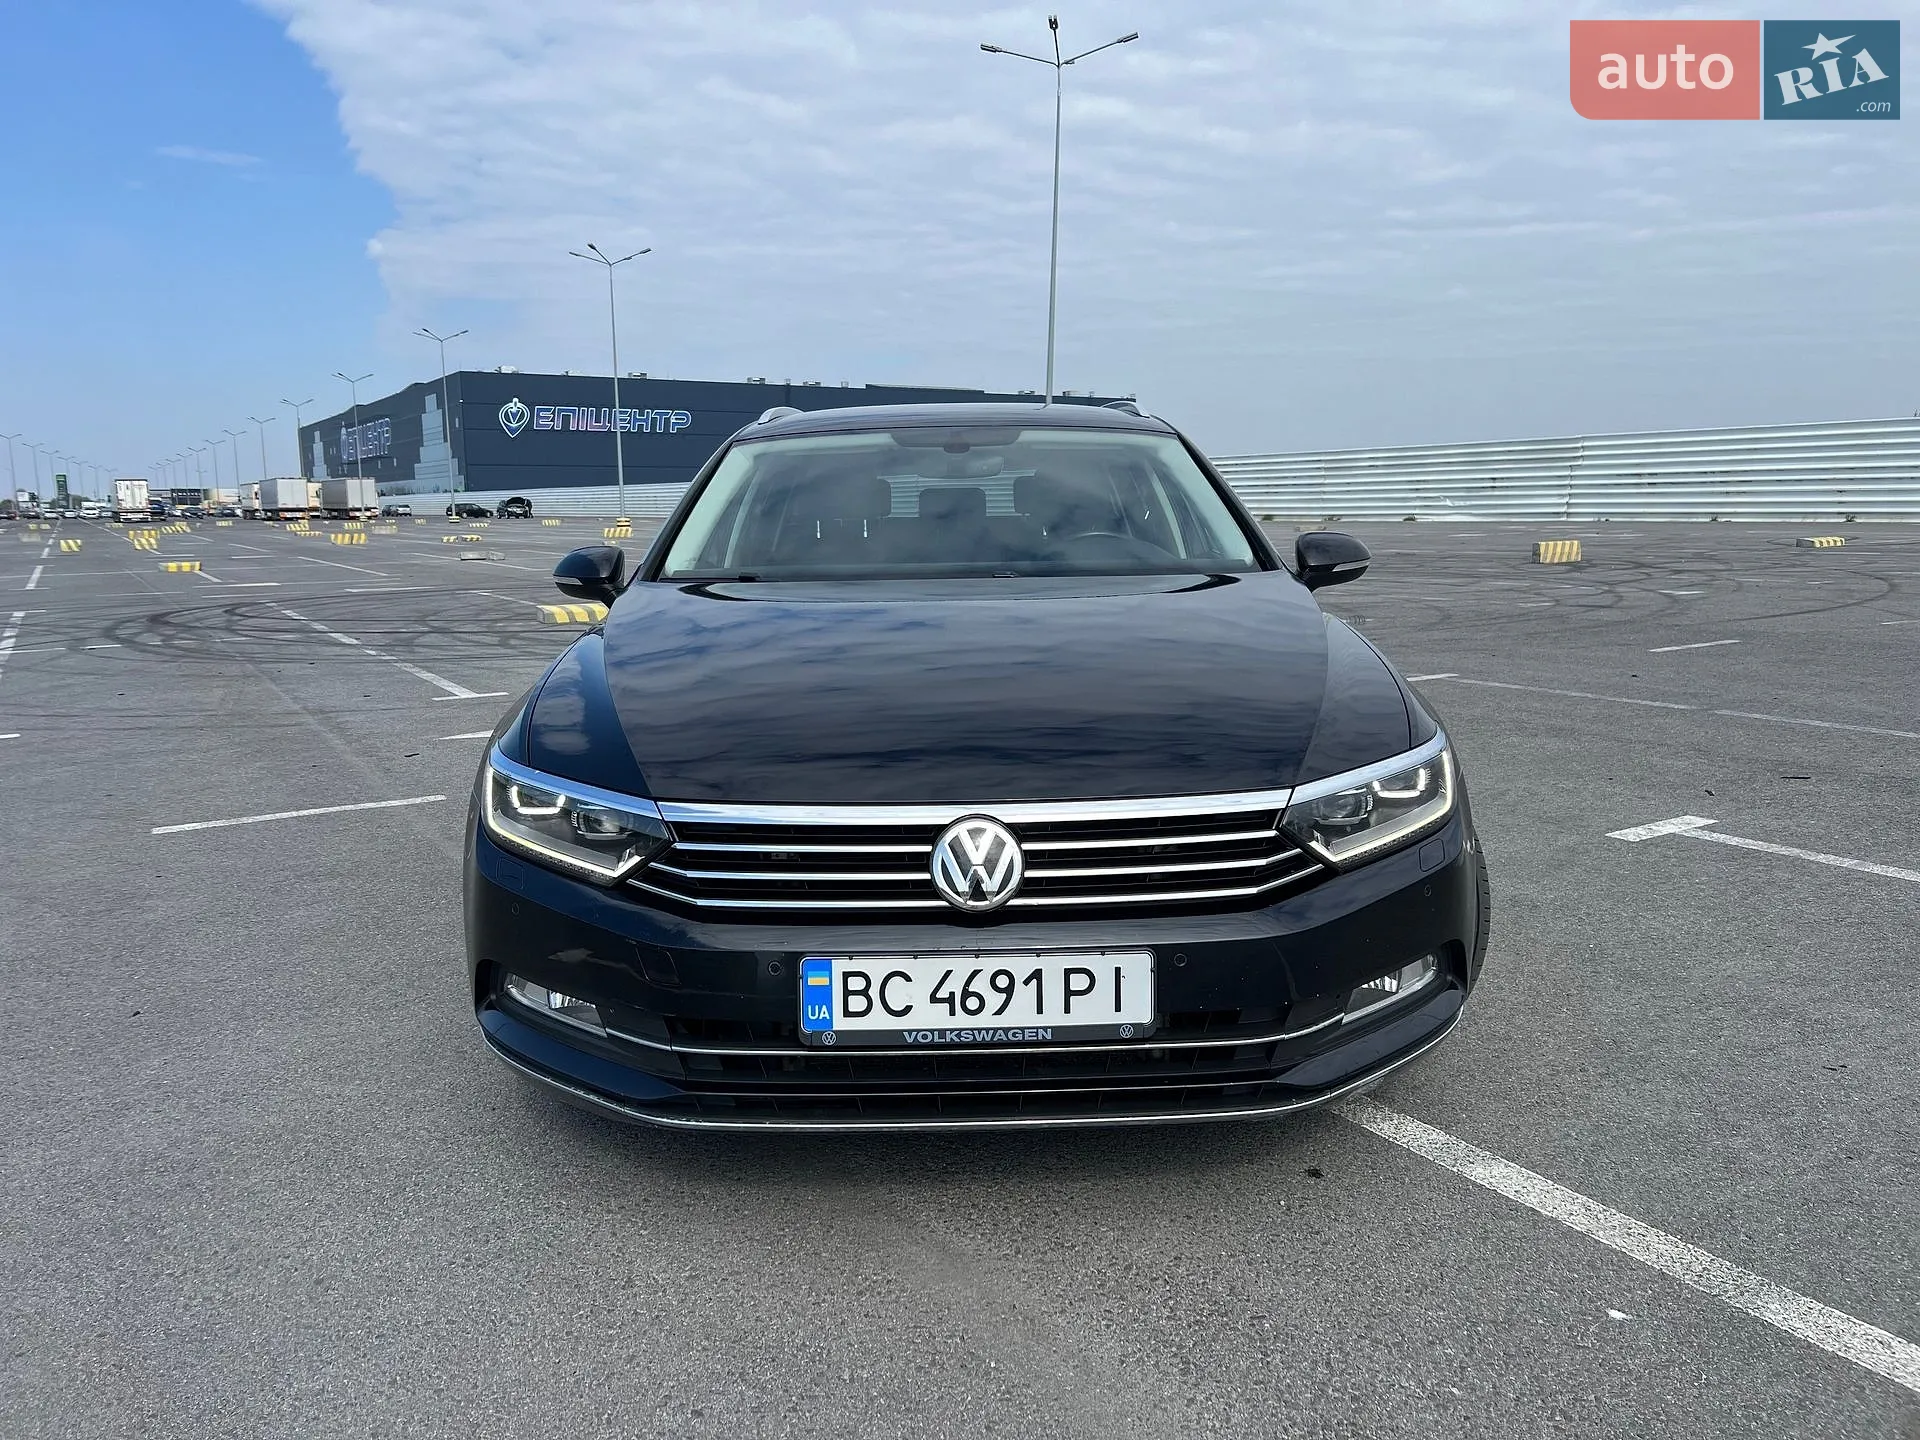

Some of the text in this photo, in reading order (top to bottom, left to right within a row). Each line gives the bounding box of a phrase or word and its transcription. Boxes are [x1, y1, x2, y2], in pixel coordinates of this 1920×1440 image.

[534, 406, 692, 433] ЕПІЦЕНТР
[842, 970, 913, 1018] BC
[929, 968, 1043, 1016] 4691
[808, 1005, 830, 1020] UA
[903, 1029, 1052, 1043] VOLKSWAGEN
